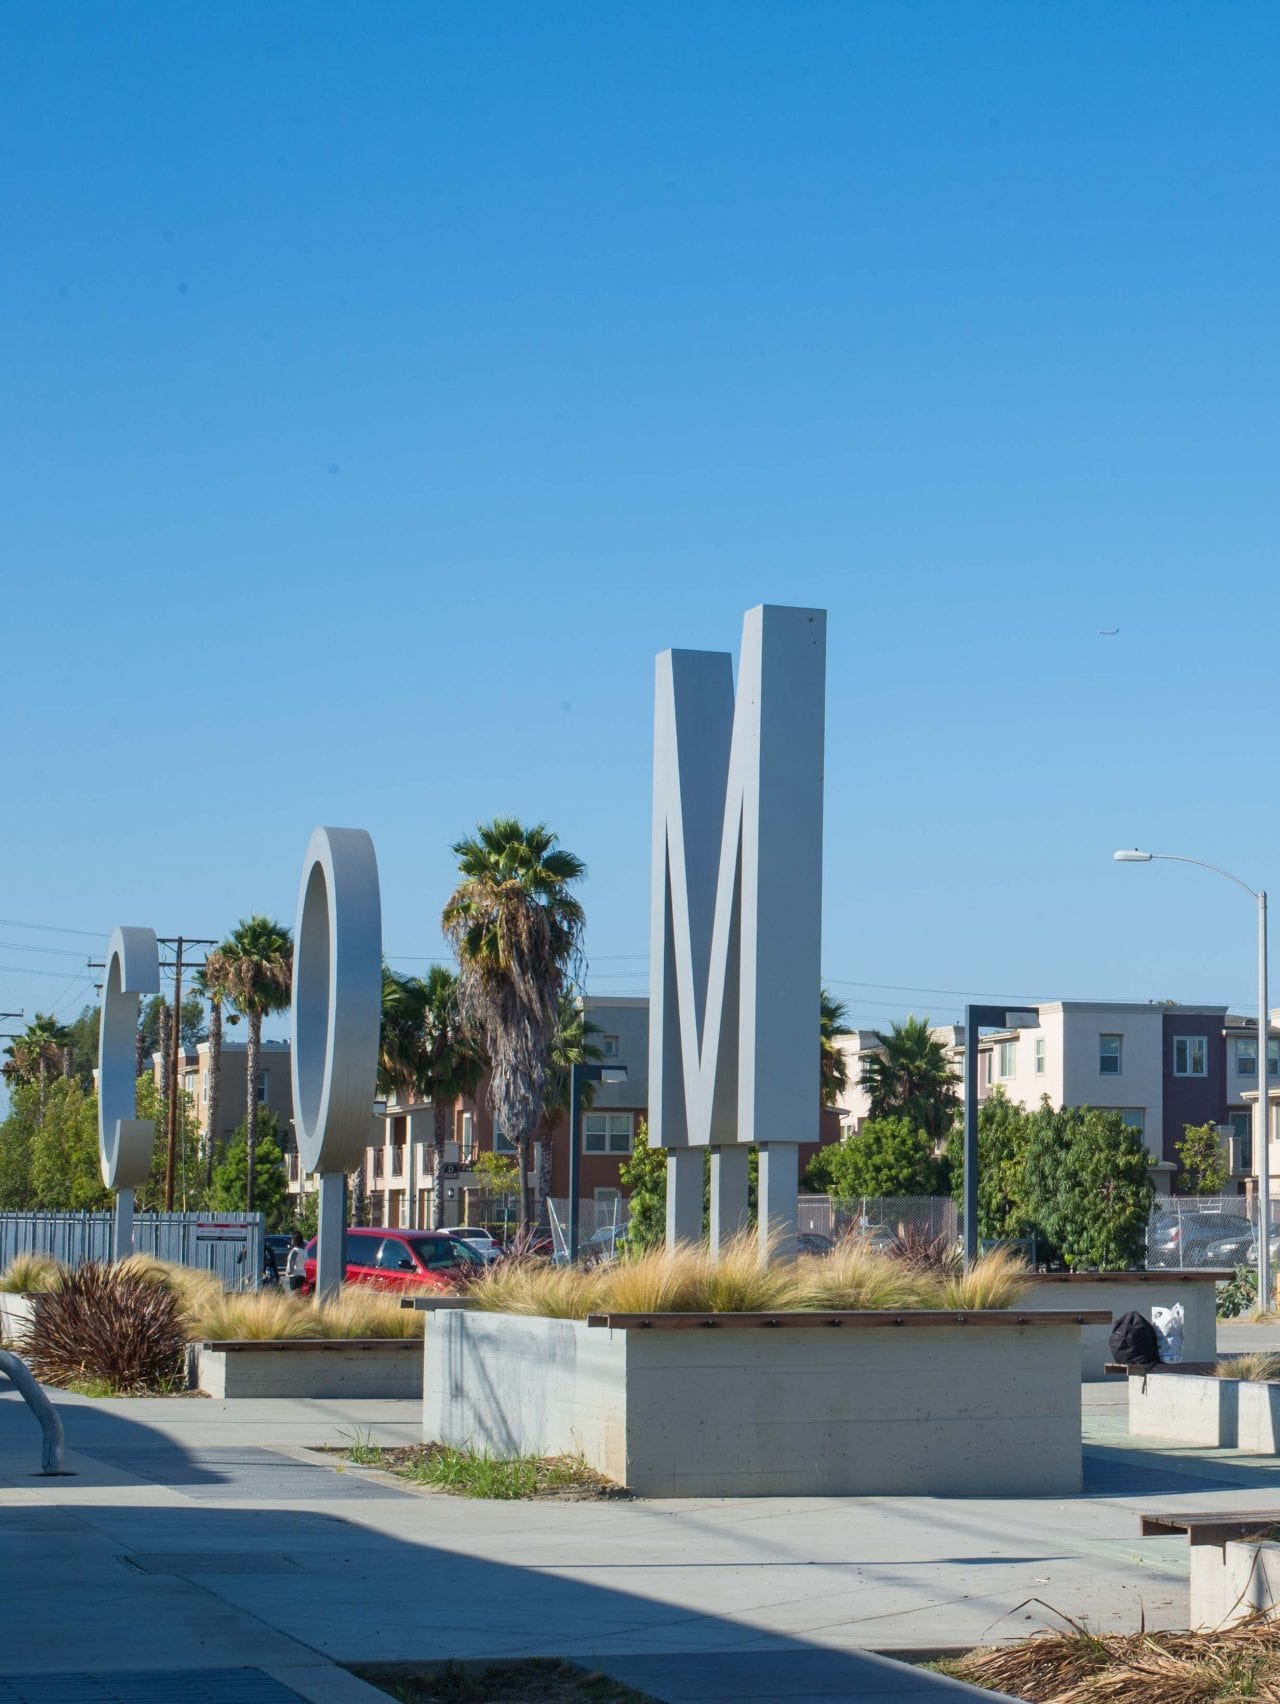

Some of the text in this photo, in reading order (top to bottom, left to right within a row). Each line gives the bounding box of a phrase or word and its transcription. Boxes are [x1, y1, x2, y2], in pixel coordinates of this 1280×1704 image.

[98, 926, 160, 1190] C
[291, 826, 382, 1174] O
[648, 603, 828, 1148] M
